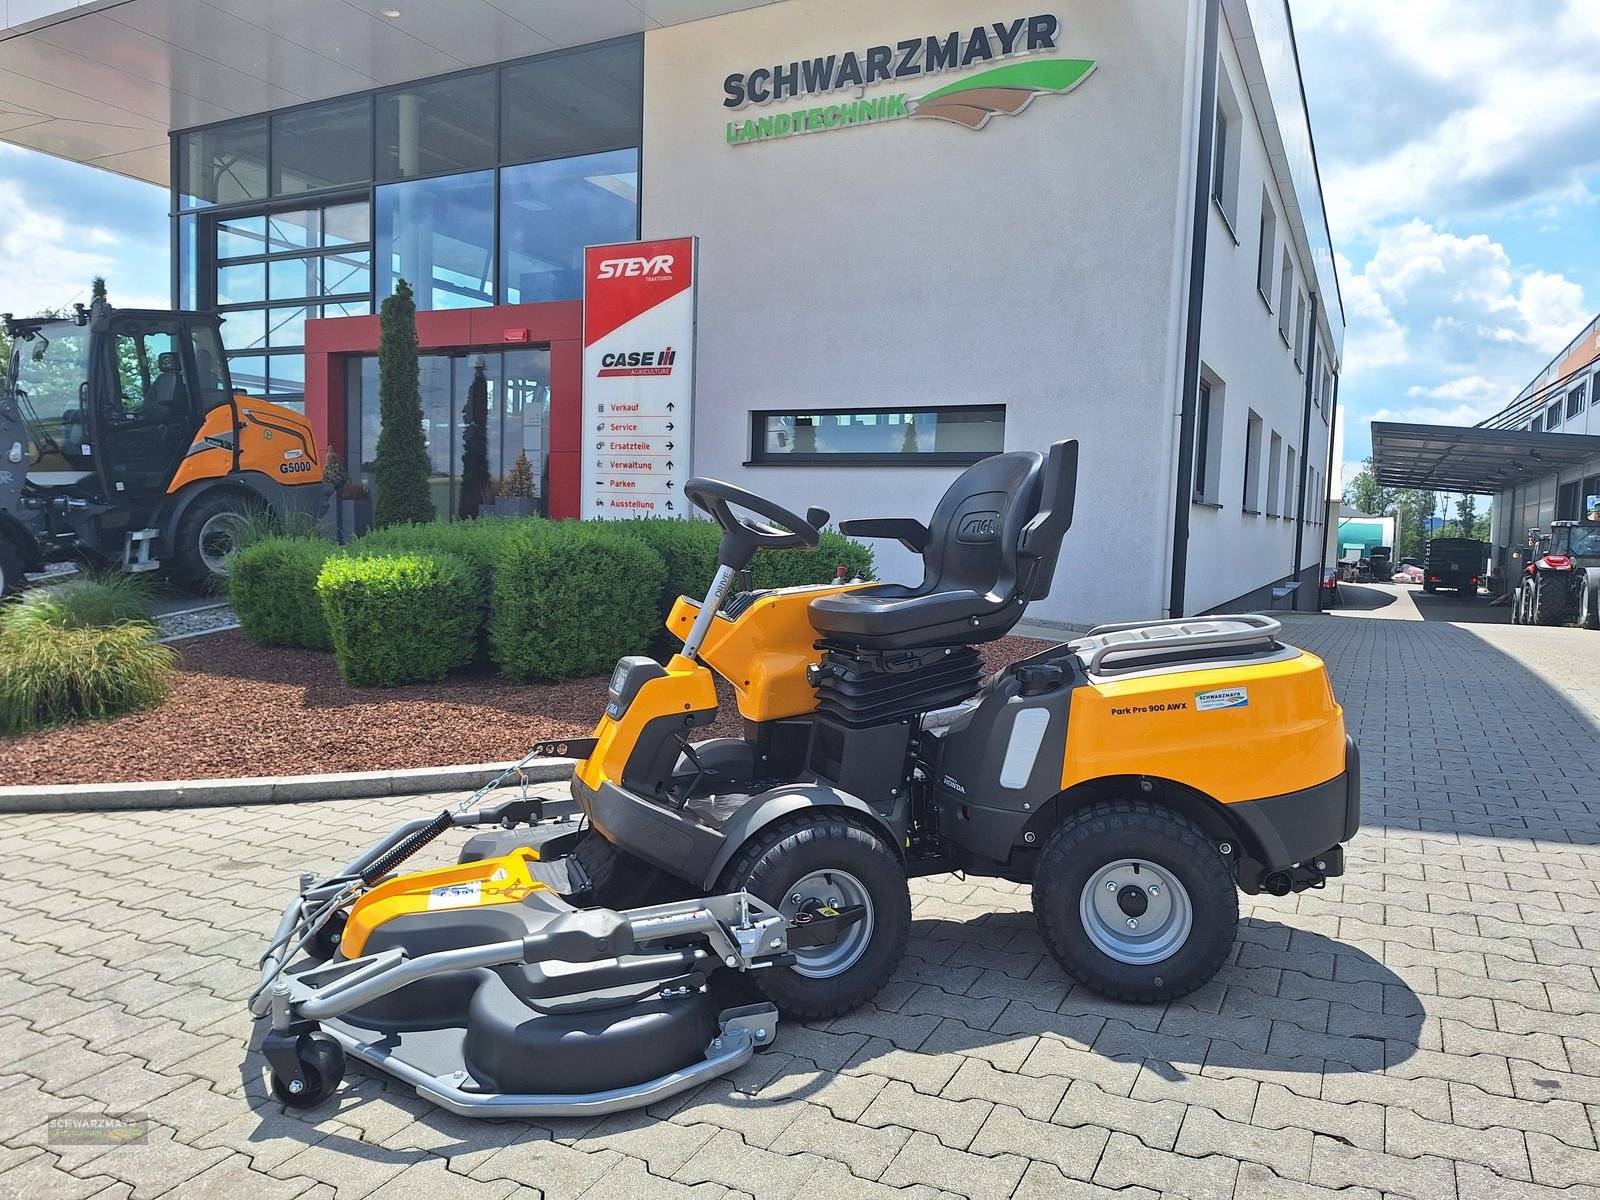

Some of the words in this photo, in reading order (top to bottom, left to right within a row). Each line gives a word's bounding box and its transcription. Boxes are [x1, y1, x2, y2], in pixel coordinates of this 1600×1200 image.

[723, 13, 1061, 110] SCHWARZMAYR
[726, 93, 909, 145] LANDTECHNIK
[597, 255, 674, 279] STEYR
[602, 352, 654, 367] CASE
[611, 403, 639, 411] Verkauf
[610, 423, 637, 431] Service
[610, 442, 650, 450] Ersatzteile
[280, 461, 311, 473] G5000
[610, 461, 652, 470] Verwaltung
[610, 500, 654, 509] Ausstellung
[714, 571, 731, 598] DRIVE
[1111, 707, 1131, 716] Park
[1132, 705, 1147, 714] Pro
[1148, 704, 1165, 712] 900
[1166, 702, 1188, 711] AWX
[943, 777, 967, 794] HONDA
